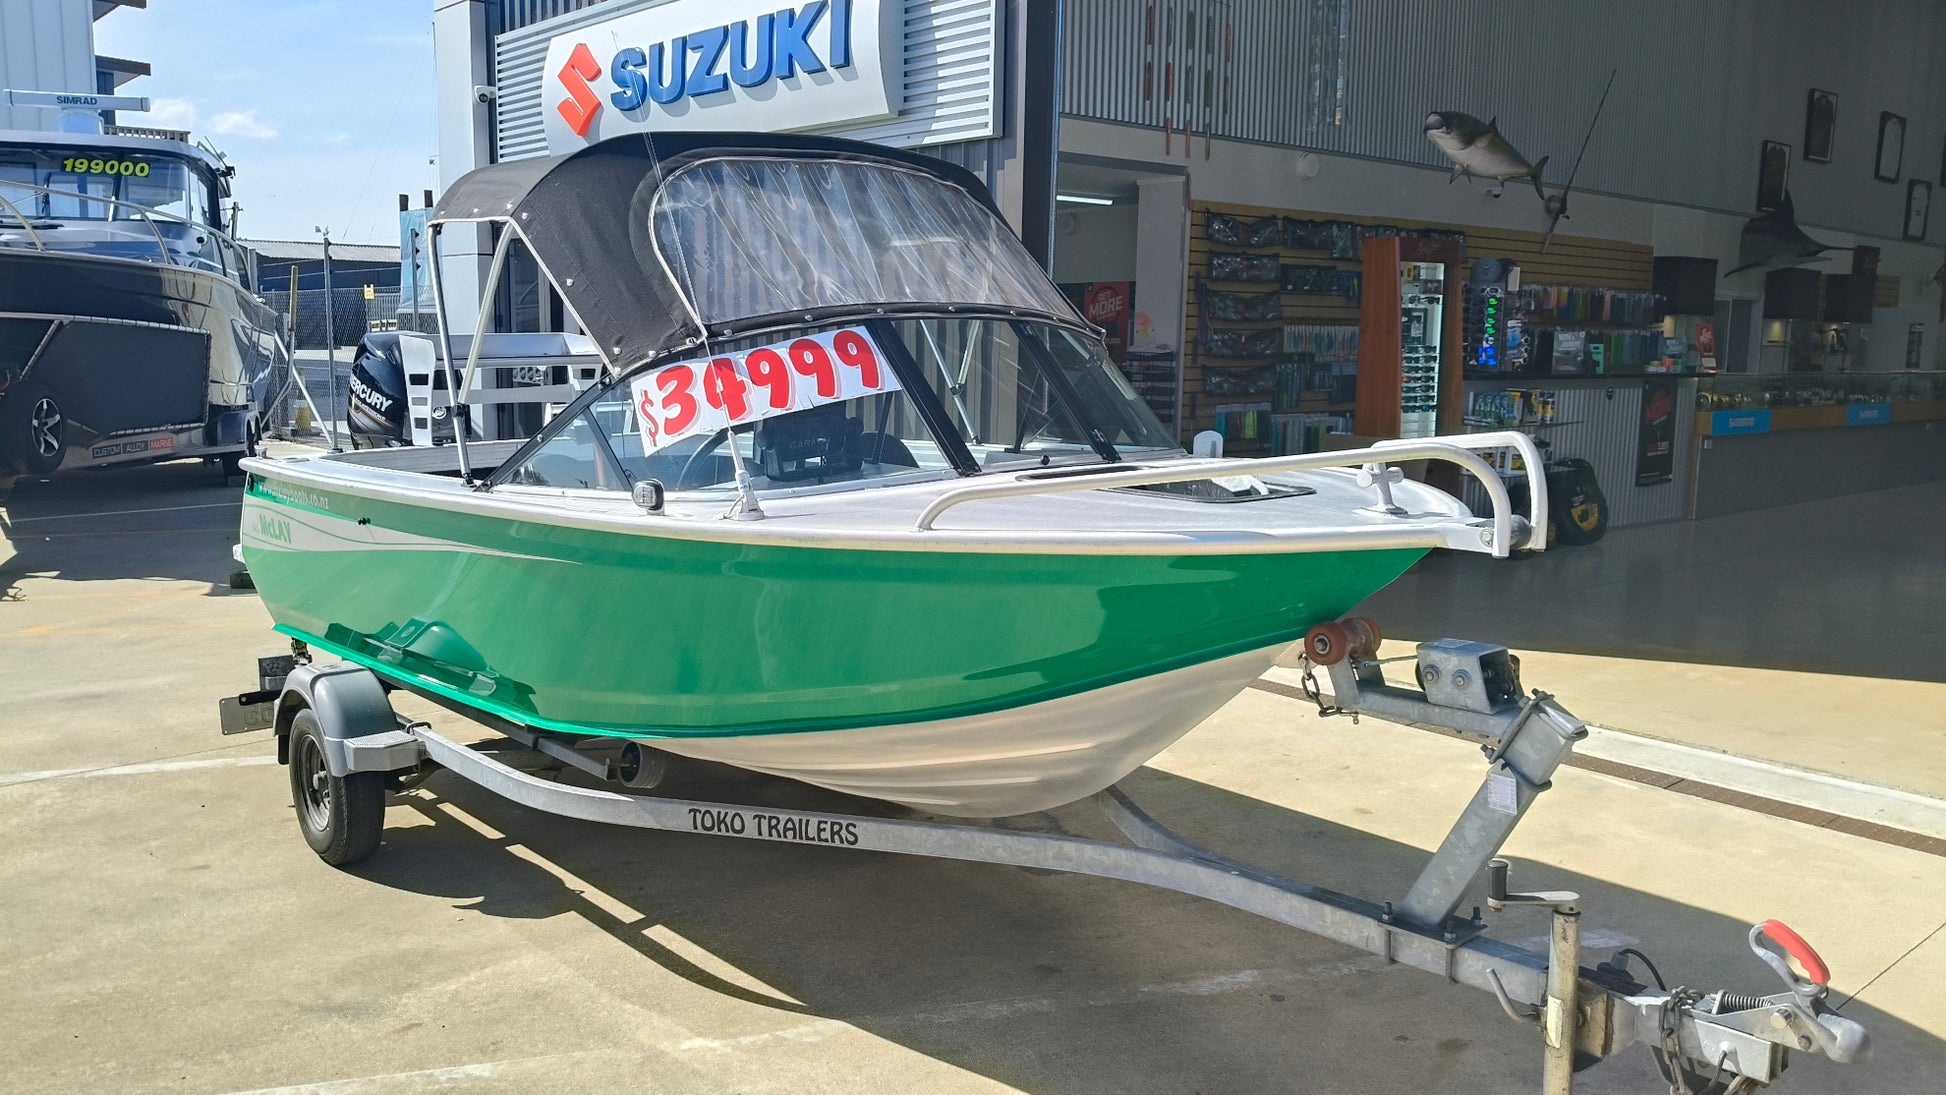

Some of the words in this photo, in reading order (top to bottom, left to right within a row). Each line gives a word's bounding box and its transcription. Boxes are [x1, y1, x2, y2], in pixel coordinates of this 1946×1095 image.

[611, 0, 851, 111] SUZUKI
[56, 95, 98, 106] SIMRAD
[63, 158, 150, 178] 199000
[1088, 295, 1123, 318] MORE
[350, 374, 393, 412] ERCURY
[639, 329, 883, 446] $34999
[94, 446, 120, 457] CUSTOM
[126, 441, 145, 452] ALLOY
[149, 438, 173, 448] MARINE
[789, 438, 823, 449] GARM
[259, 514, 292, 544] McLAY
[688, 808, 746, 834] TOKO
[753, 814, 860, 845] TRAILERS
